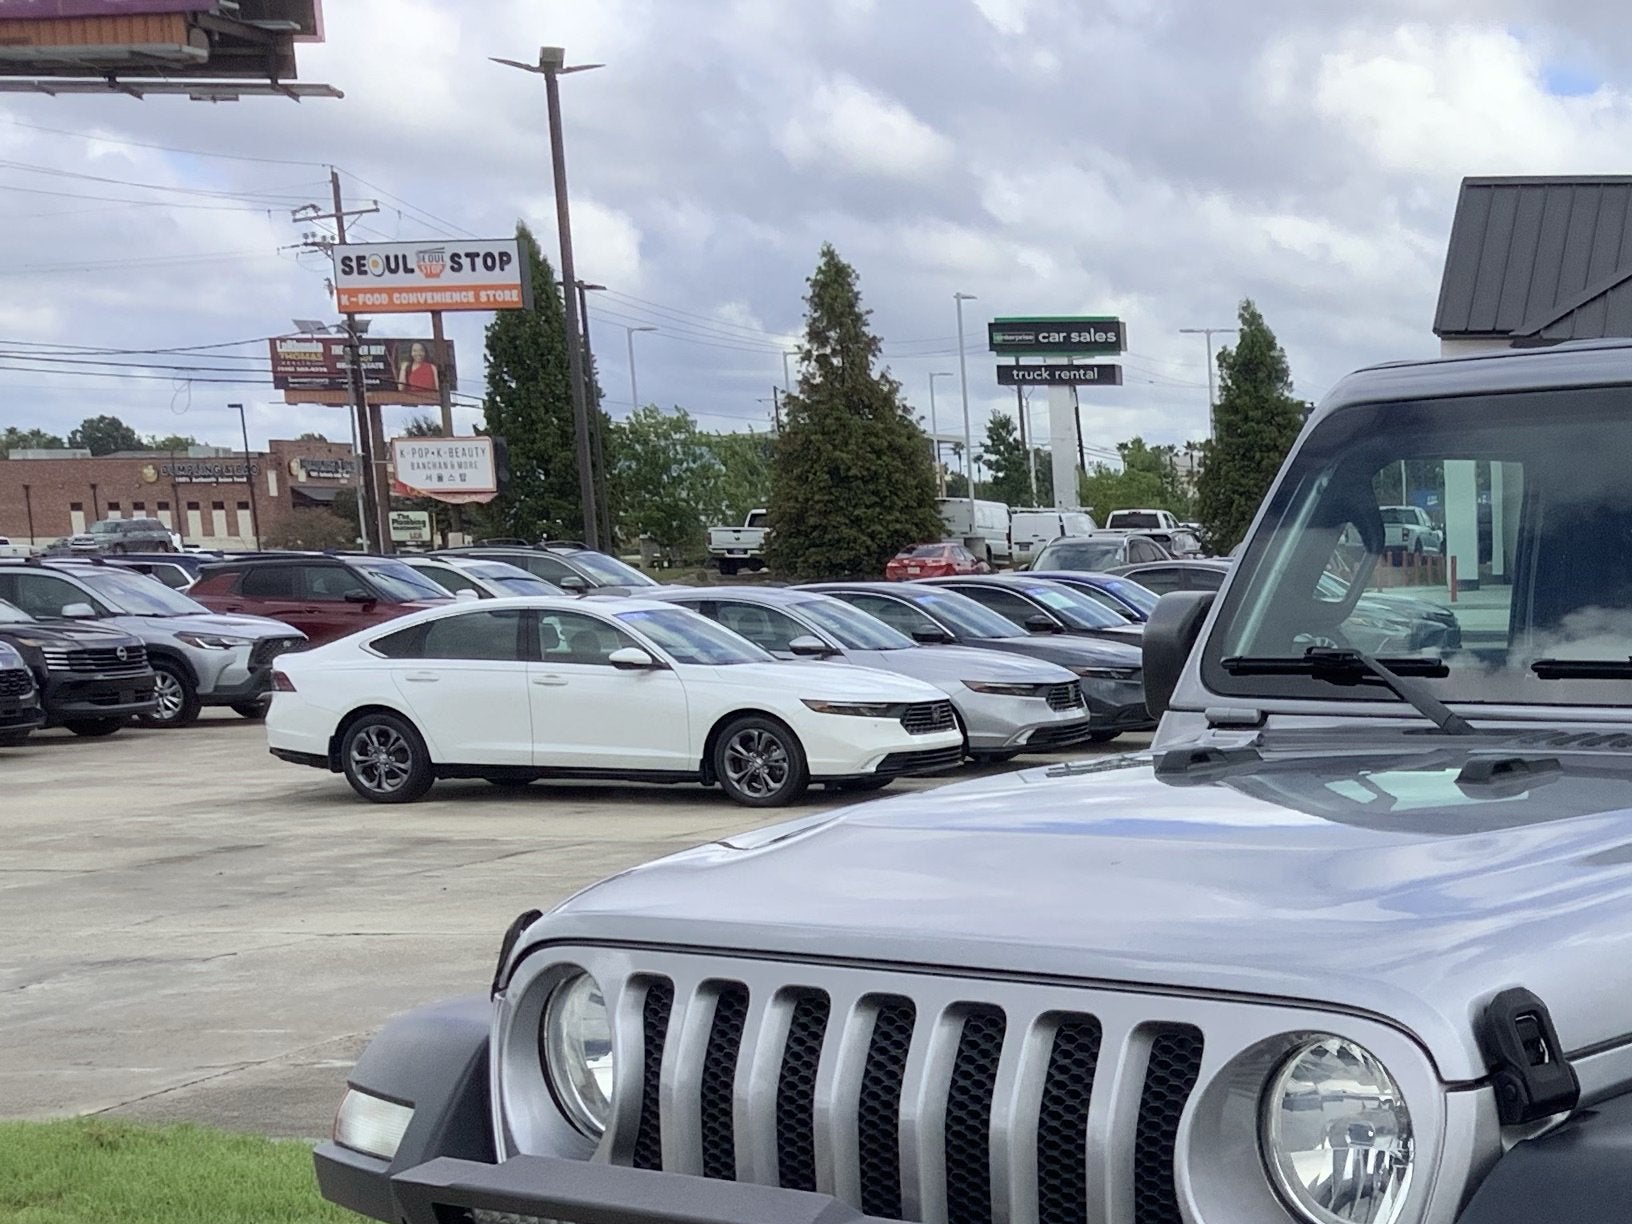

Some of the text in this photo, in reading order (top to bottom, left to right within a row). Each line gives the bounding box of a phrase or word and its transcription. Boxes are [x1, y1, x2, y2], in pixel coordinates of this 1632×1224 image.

[341, 252, 512, 277] SEOUL STOP
[340, 289, 519, 306] K-FOOD CONVENIENCE STORE
[1038, 332, 1067, 342] car
[1070, 327, 1117, 342] sales
[1012, 366, 1098, 380] truck rental
